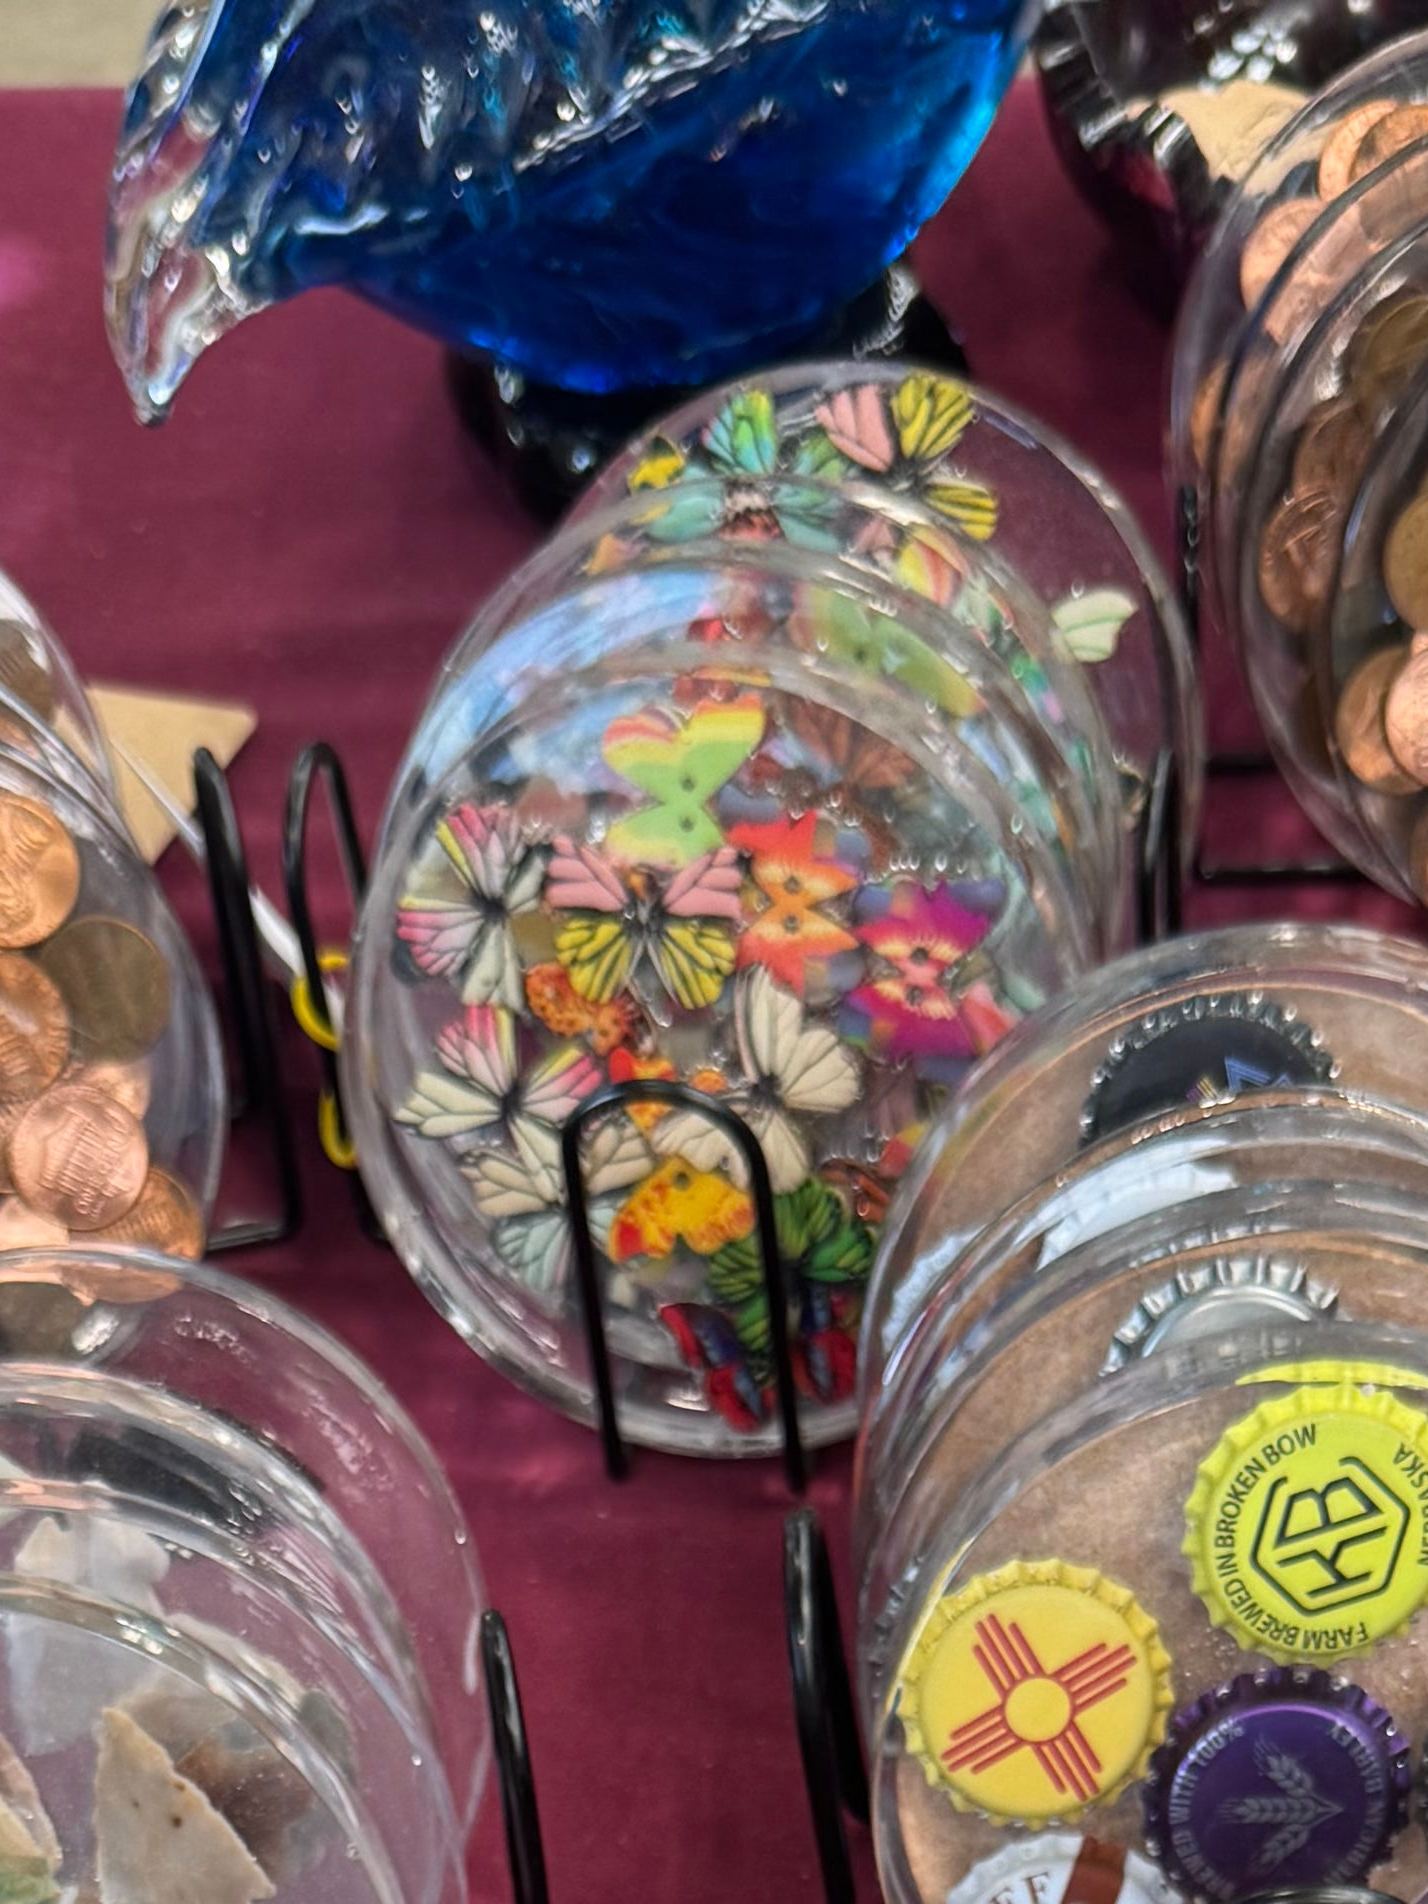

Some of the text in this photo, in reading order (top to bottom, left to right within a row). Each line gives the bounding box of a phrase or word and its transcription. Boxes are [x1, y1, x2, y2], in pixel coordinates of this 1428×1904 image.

[1261, 1423, 1317, 1466] BOW
[1215, 1457, 1268, 1548] BROKEN
[1215, 1551, 1237, 1577] IN
[1302, 1620, 1369, 1650] FARM
